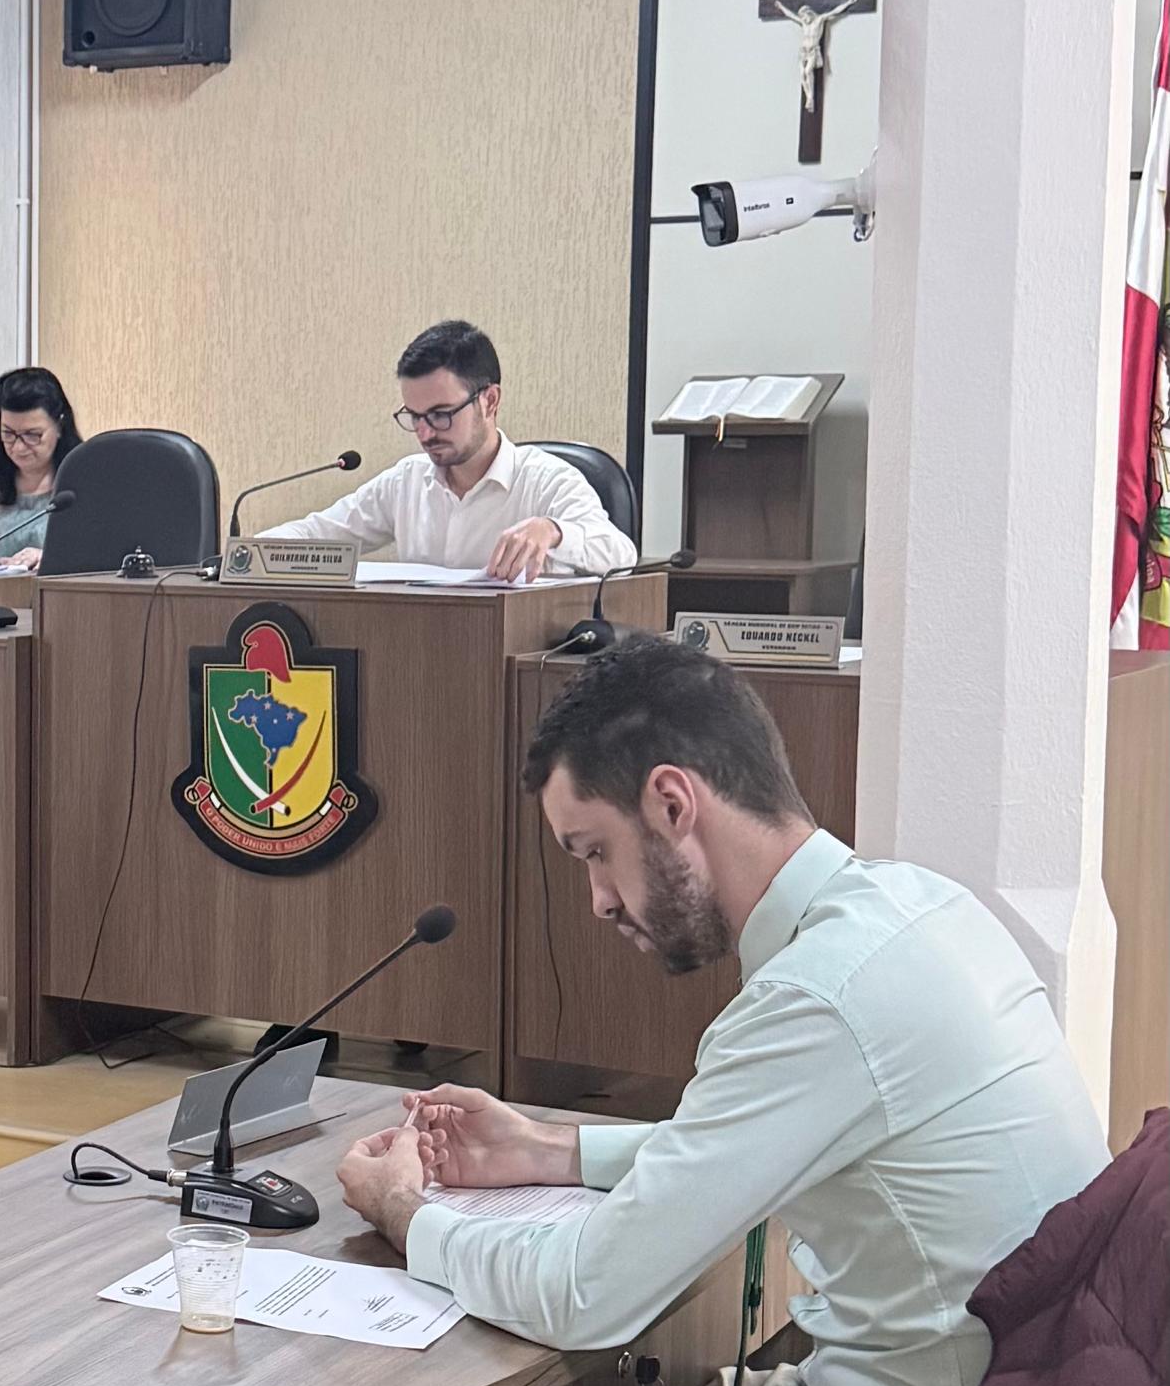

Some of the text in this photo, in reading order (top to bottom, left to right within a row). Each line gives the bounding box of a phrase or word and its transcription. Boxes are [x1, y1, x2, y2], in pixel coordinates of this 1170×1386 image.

[270, 553, 343, 564] GUILHERME DA SILVA
[740, 631, 820, 643] EDUARDO NECKEL
[211, 816, 240, 843] PODER
[242, 837, 273, 851] UNIDO
